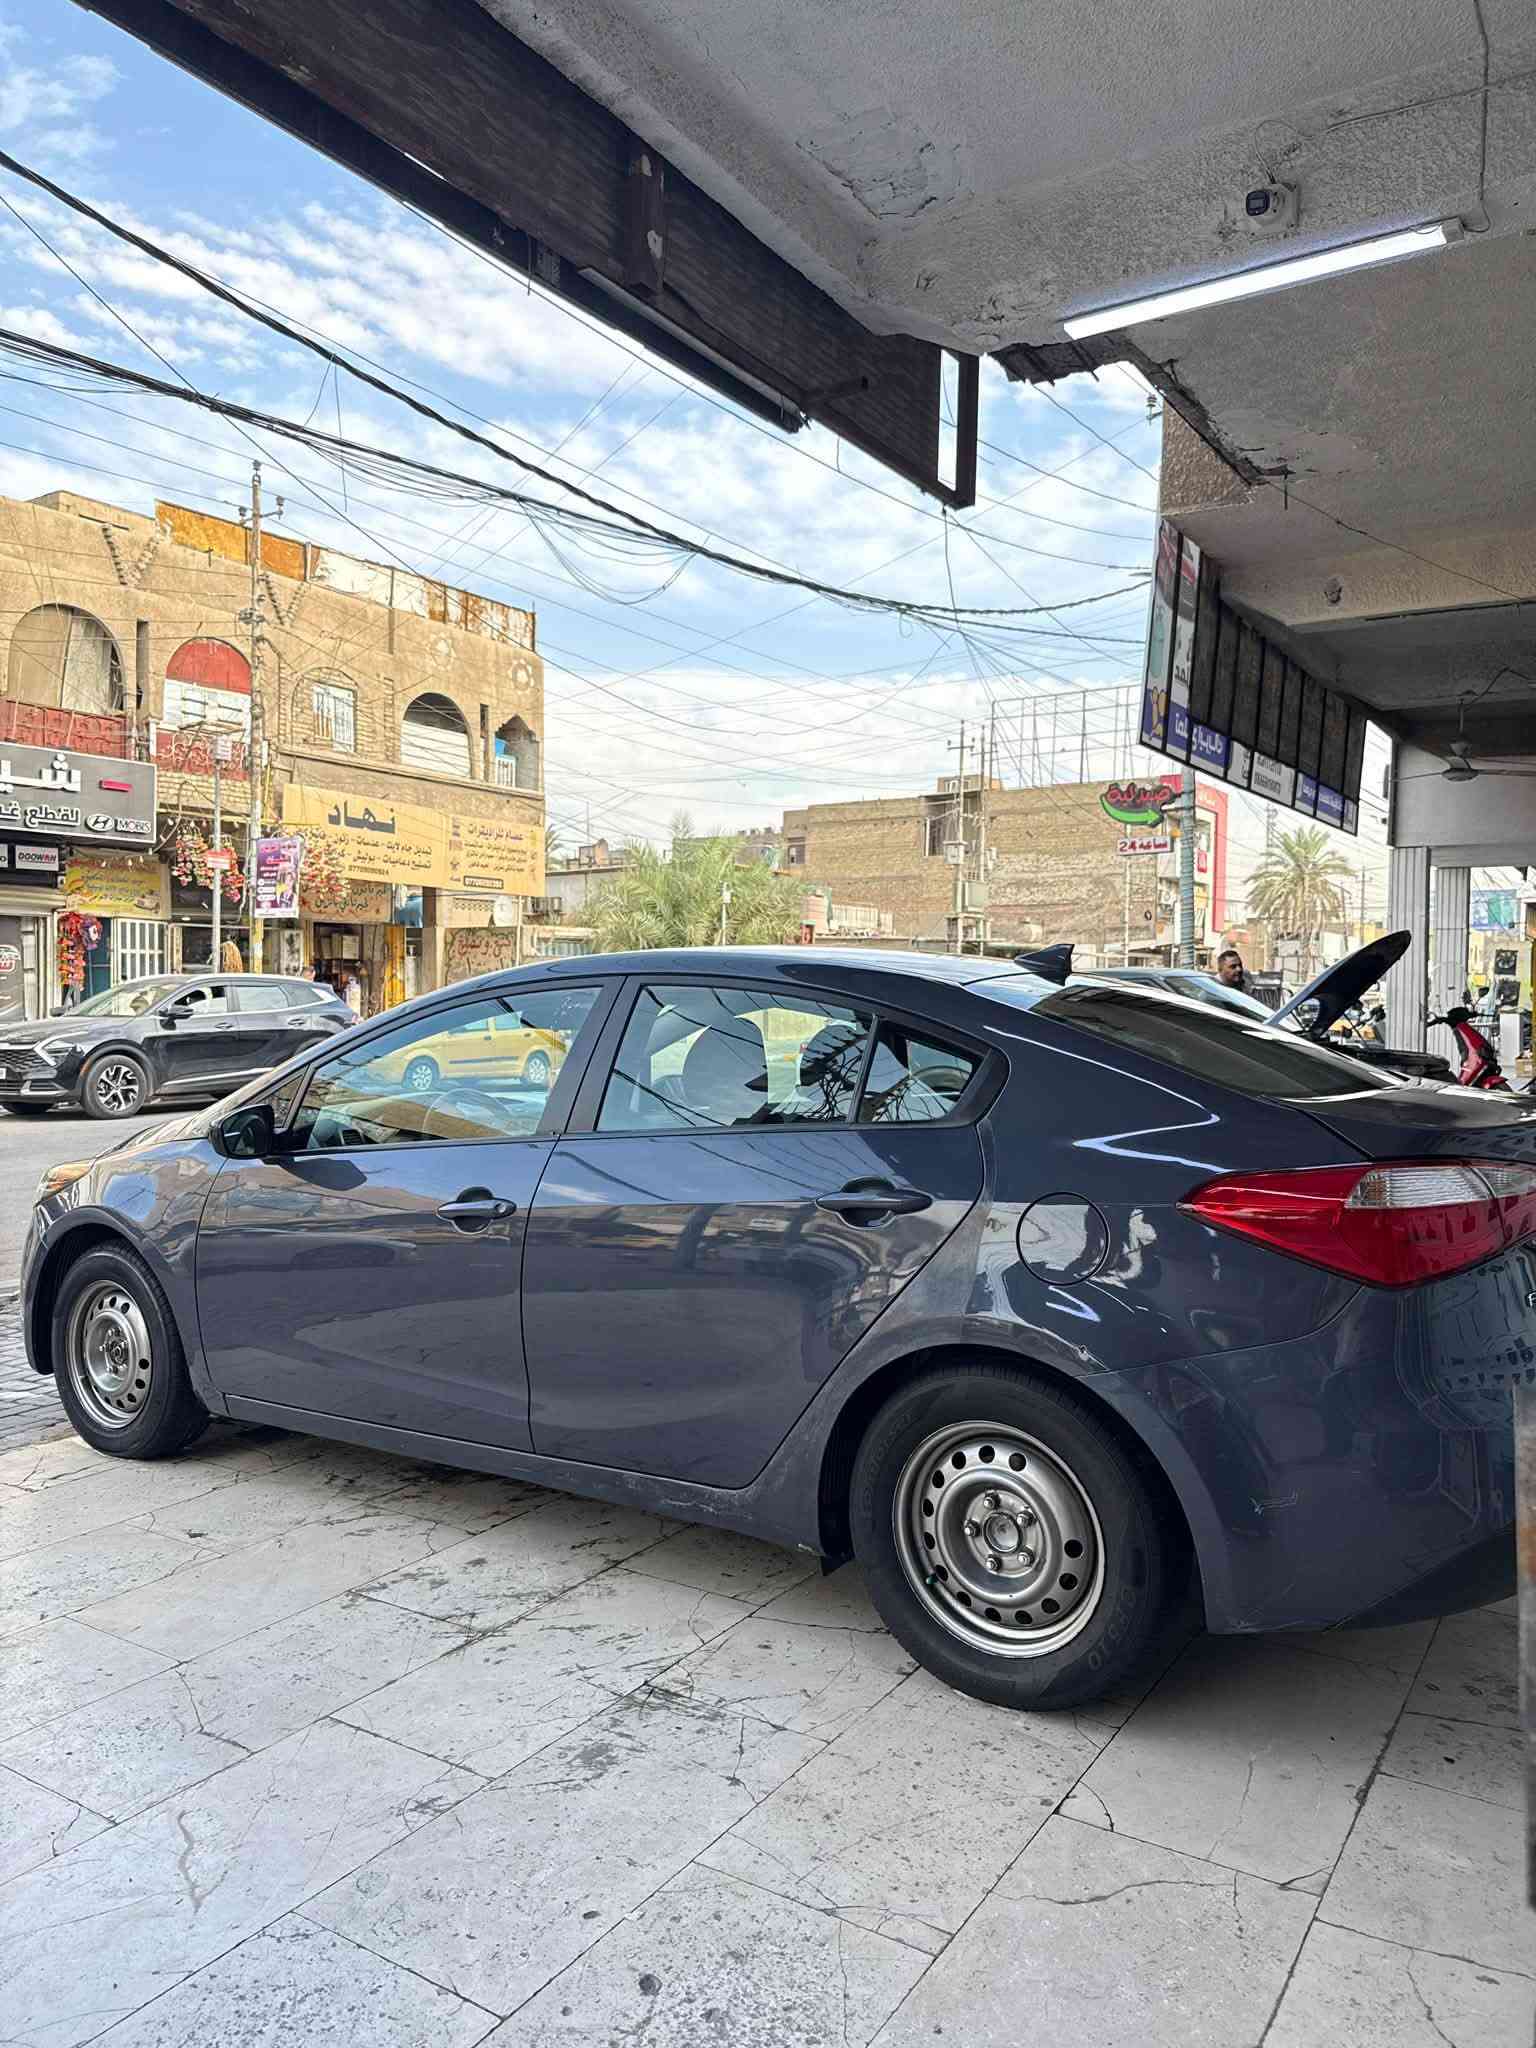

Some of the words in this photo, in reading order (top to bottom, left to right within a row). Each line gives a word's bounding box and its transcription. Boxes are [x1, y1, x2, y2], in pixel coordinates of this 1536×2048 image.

[25, 804, 81, 828] لقطع
[116, 817, 152, 834] MOBIS
[328, 800, 396, 834] نهاد
[1119, 840, 1137, 852] 24
